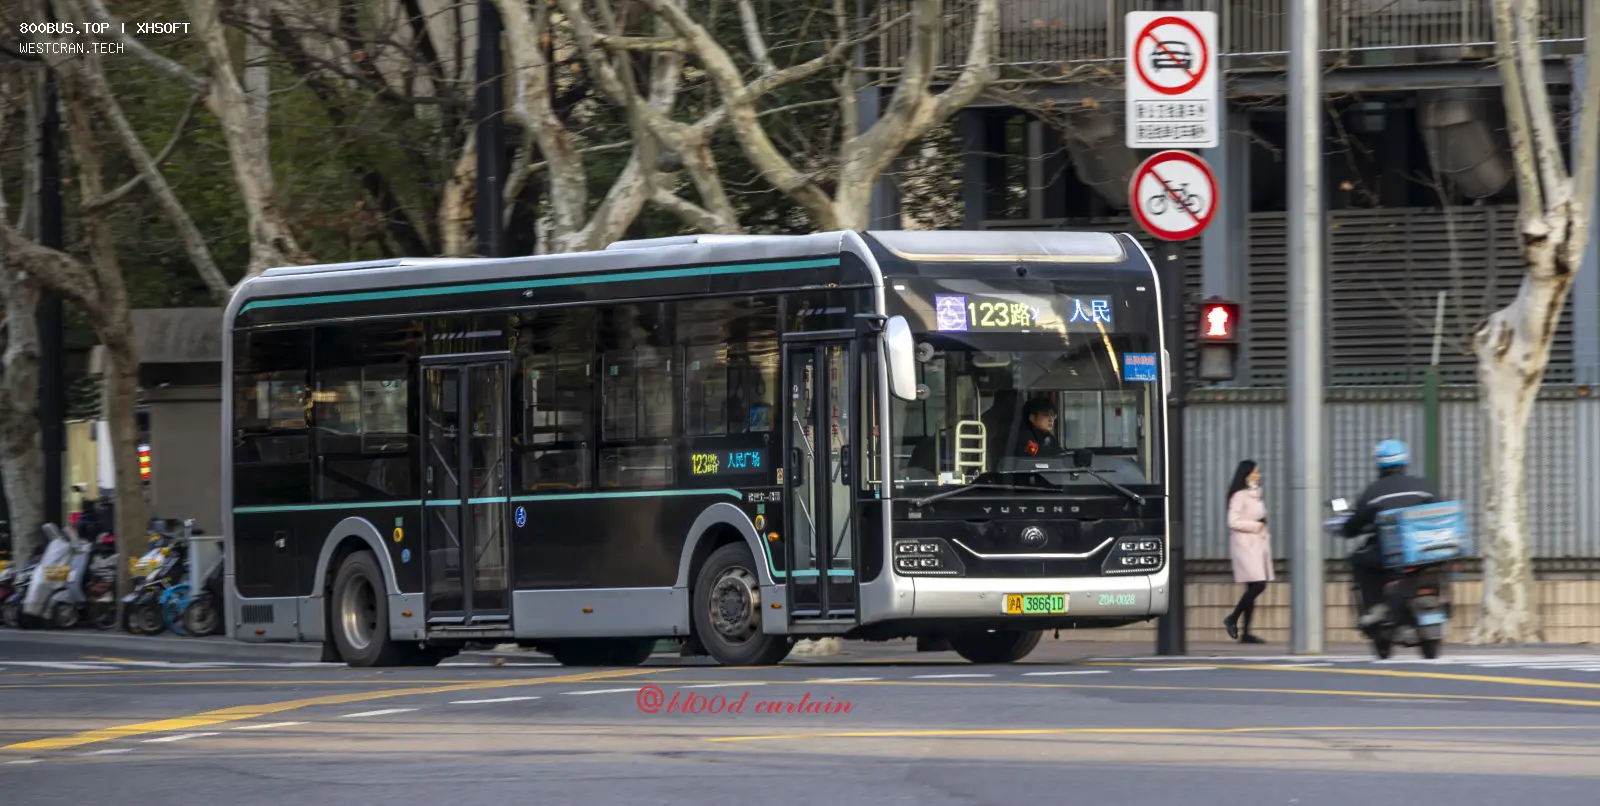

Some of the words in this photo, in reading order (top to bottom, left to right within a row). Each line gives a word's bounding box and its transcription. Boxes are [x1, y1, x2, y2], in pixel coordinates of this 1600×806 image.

[968, 302, 1030, 327] 123路
[1069, 299, 1112, 323] 人民
[691, 453, 718, 474] 123路
[727, 451, 760, 468] 人民广场
[983, 506, 1080, 514] YUTONG
